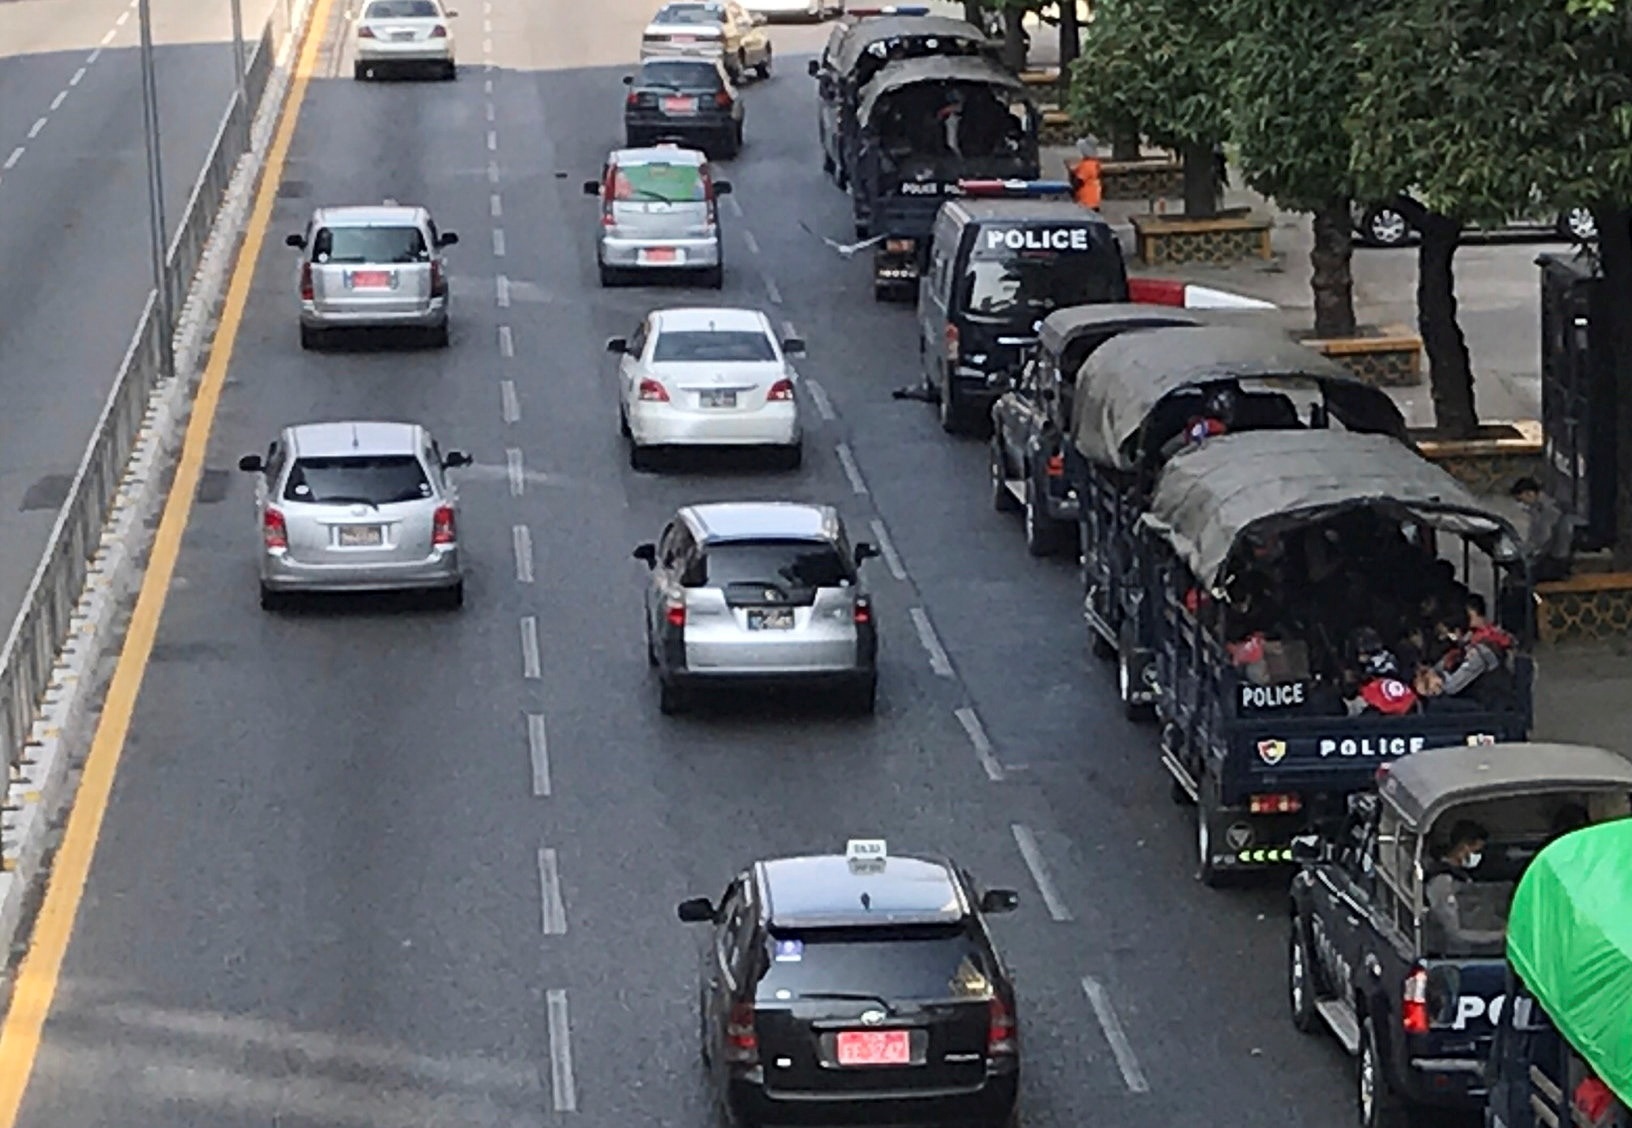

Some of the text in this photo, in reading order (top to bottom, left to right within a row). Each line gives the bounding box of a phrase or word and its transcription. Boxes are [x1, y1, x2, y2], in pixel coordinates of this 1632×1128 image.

[987, 229, 1088, 250] POLICE
[1242, 683, 1303, 707] POLICE
[1320, 737, 1425, 757] POLICE
